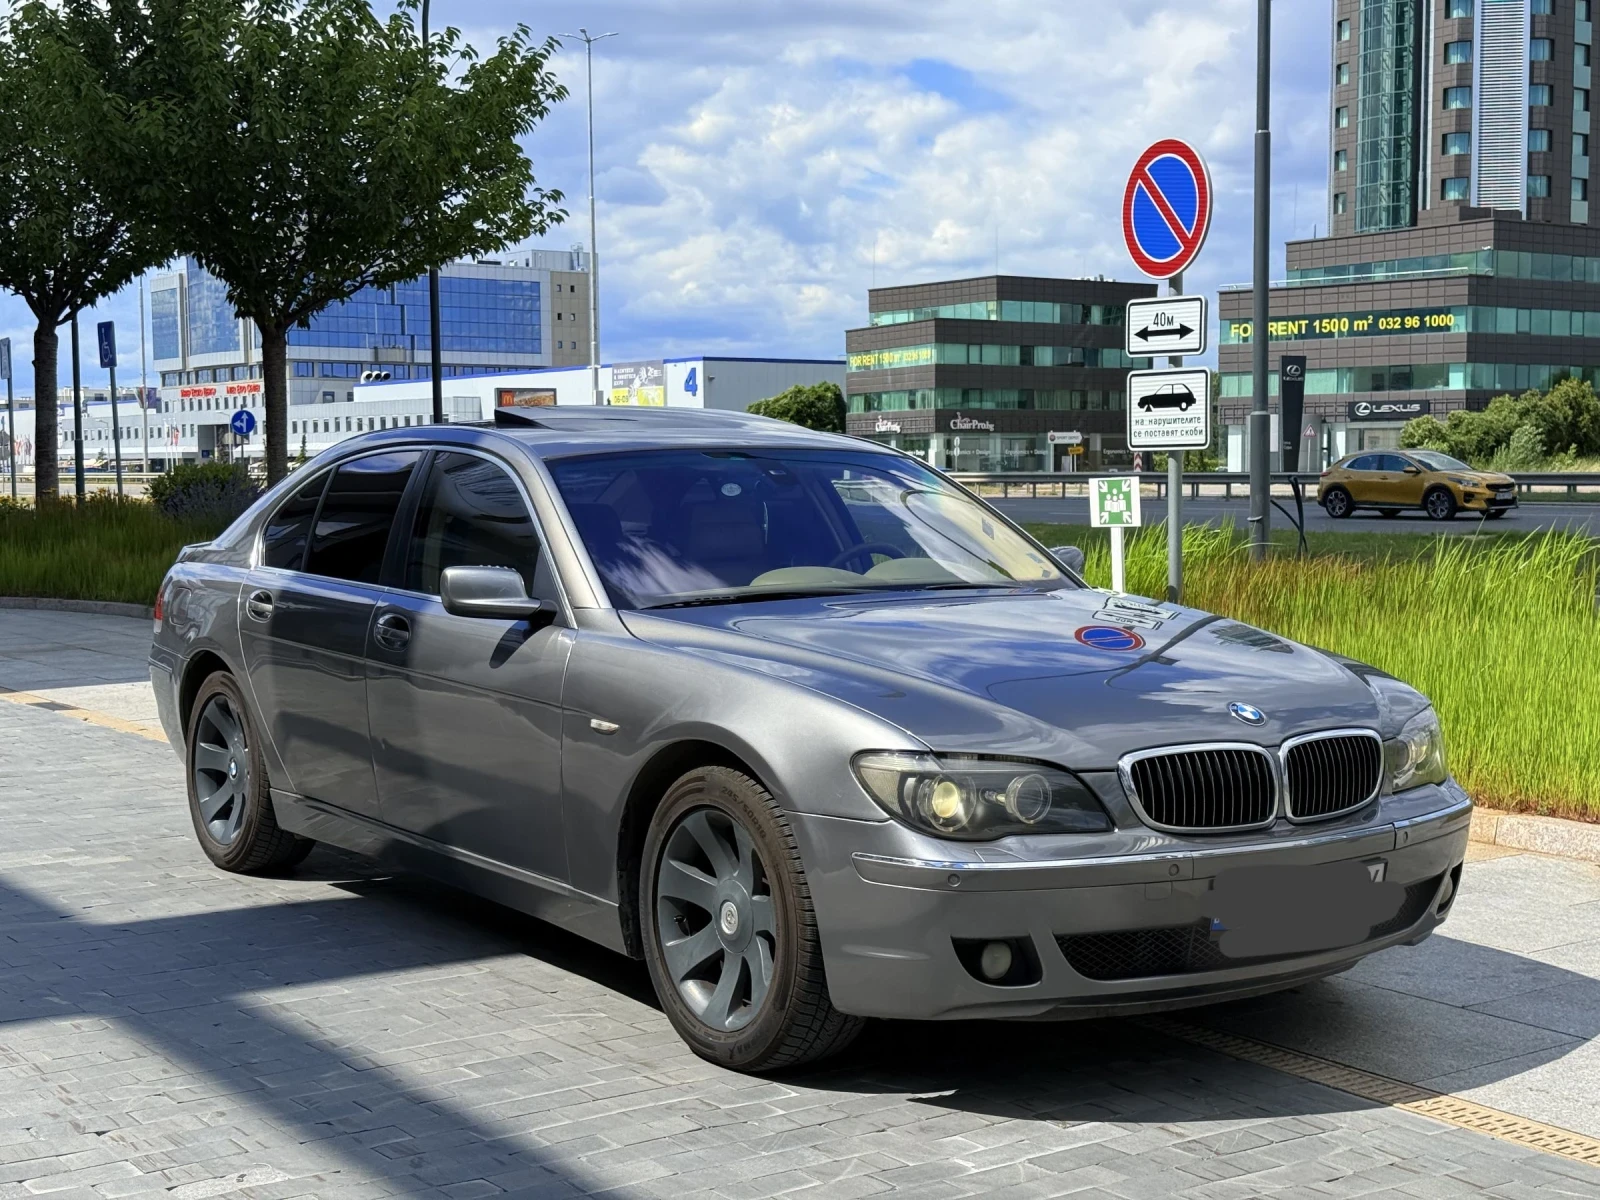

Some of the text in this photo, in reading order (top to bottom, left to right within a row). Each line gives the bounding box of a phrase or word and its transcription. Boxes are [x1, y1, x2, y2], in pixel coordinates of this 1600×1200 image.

[1153, 312, 1174, 327] 40м
[1230, 323, 1253, 337] FO
[1268, 320, 1309, 336] RENT
[1313, 318, 1349, 334] 1500
[1378, 317, 1401, 330] 032
[1404, 315, 1420, 328] 96
[1424, 314, 1454, 327] 1000
[850, 355, 862, 367] FOR
[863, 353, 878, 367] RENT
[684, 367, 698, 396] 4
[1373, 403, 1421, 413] LEXUS
[1135, 416, 1201, 427] на нарушителите
[1133, 427, 1203, 438] се поставят скоби
